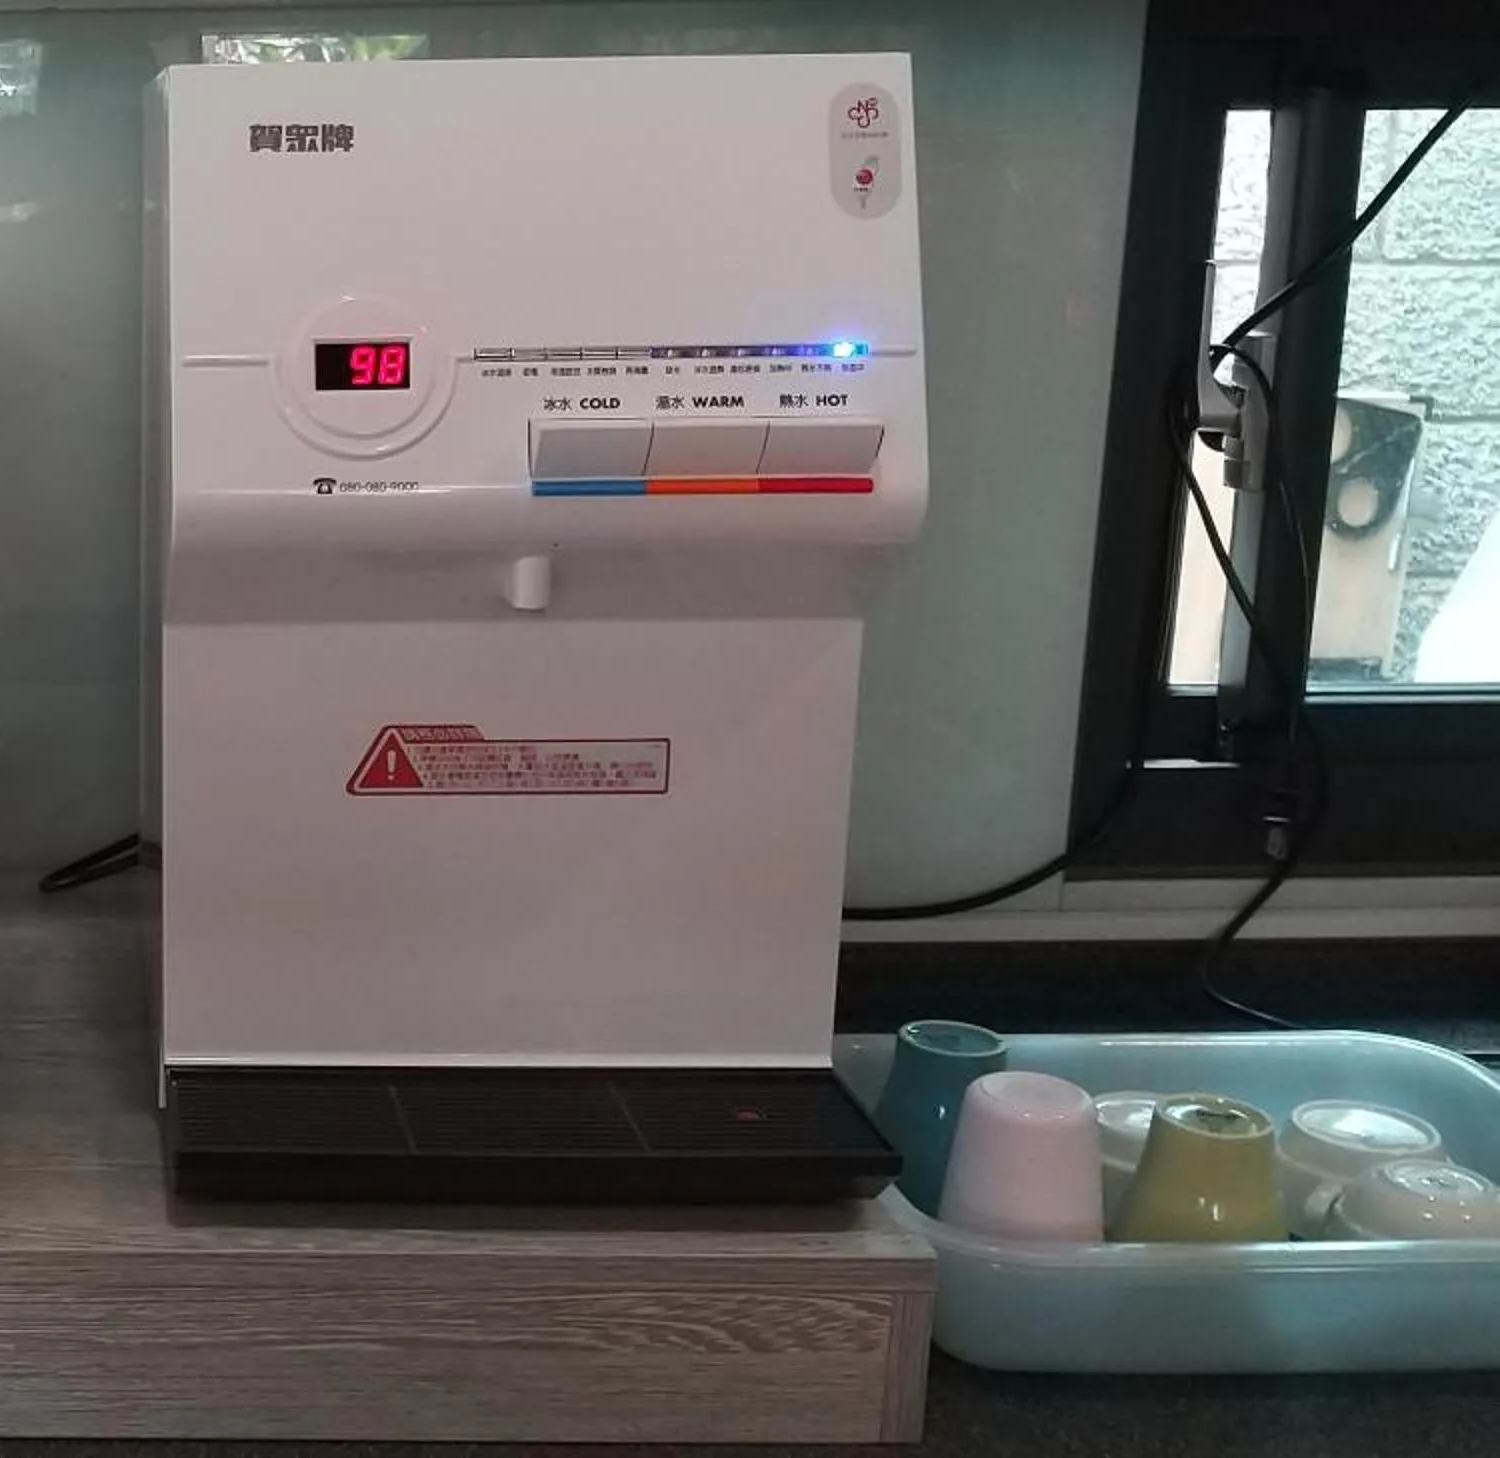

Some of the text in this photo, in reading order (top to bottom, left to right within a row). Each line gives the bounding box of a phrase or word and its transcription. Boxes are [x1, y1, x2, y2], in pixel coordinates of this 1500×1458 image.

[351, 345, 407, 385] 98
[579, 397, 621, 410] COLD
[691, 395, 745, 408] WARM
[815, 395, 849, 407] HOT
